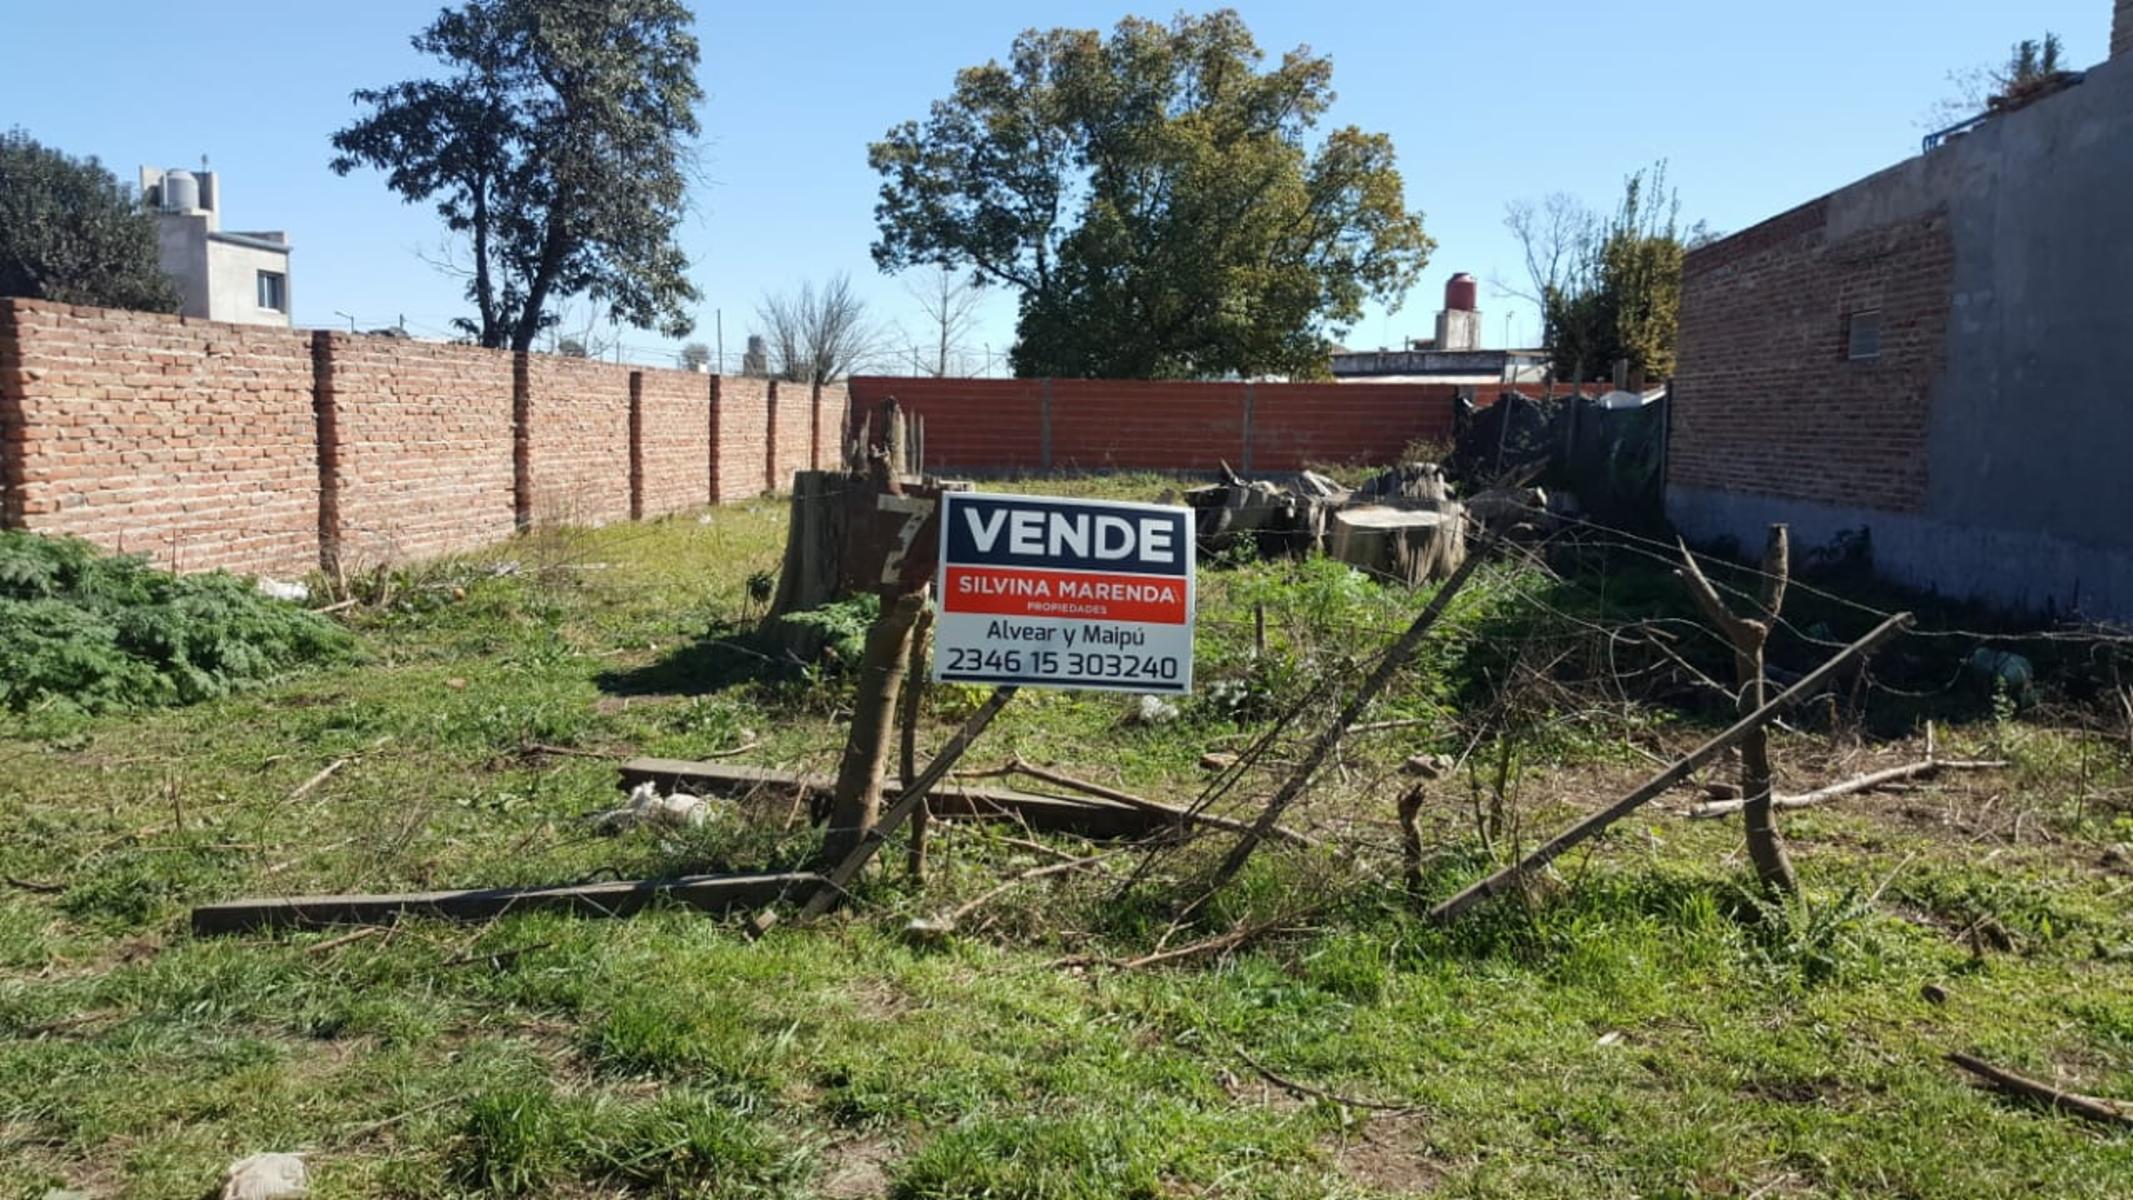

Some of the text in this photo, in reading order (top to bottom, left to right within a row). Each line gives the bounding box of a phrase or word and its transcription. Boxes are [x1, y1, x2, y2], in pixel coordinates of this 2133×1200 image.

[963, 507, 1174, 563] VENDE
[959, 575, 1175, 603] SILVINA MARENDA
[1027, 602, 1107, 615] PROPIEDADES
[986, 620, 1145, 650] Alvear y Maipú
[947, 648, 1178, 680] 2346 15 303240
